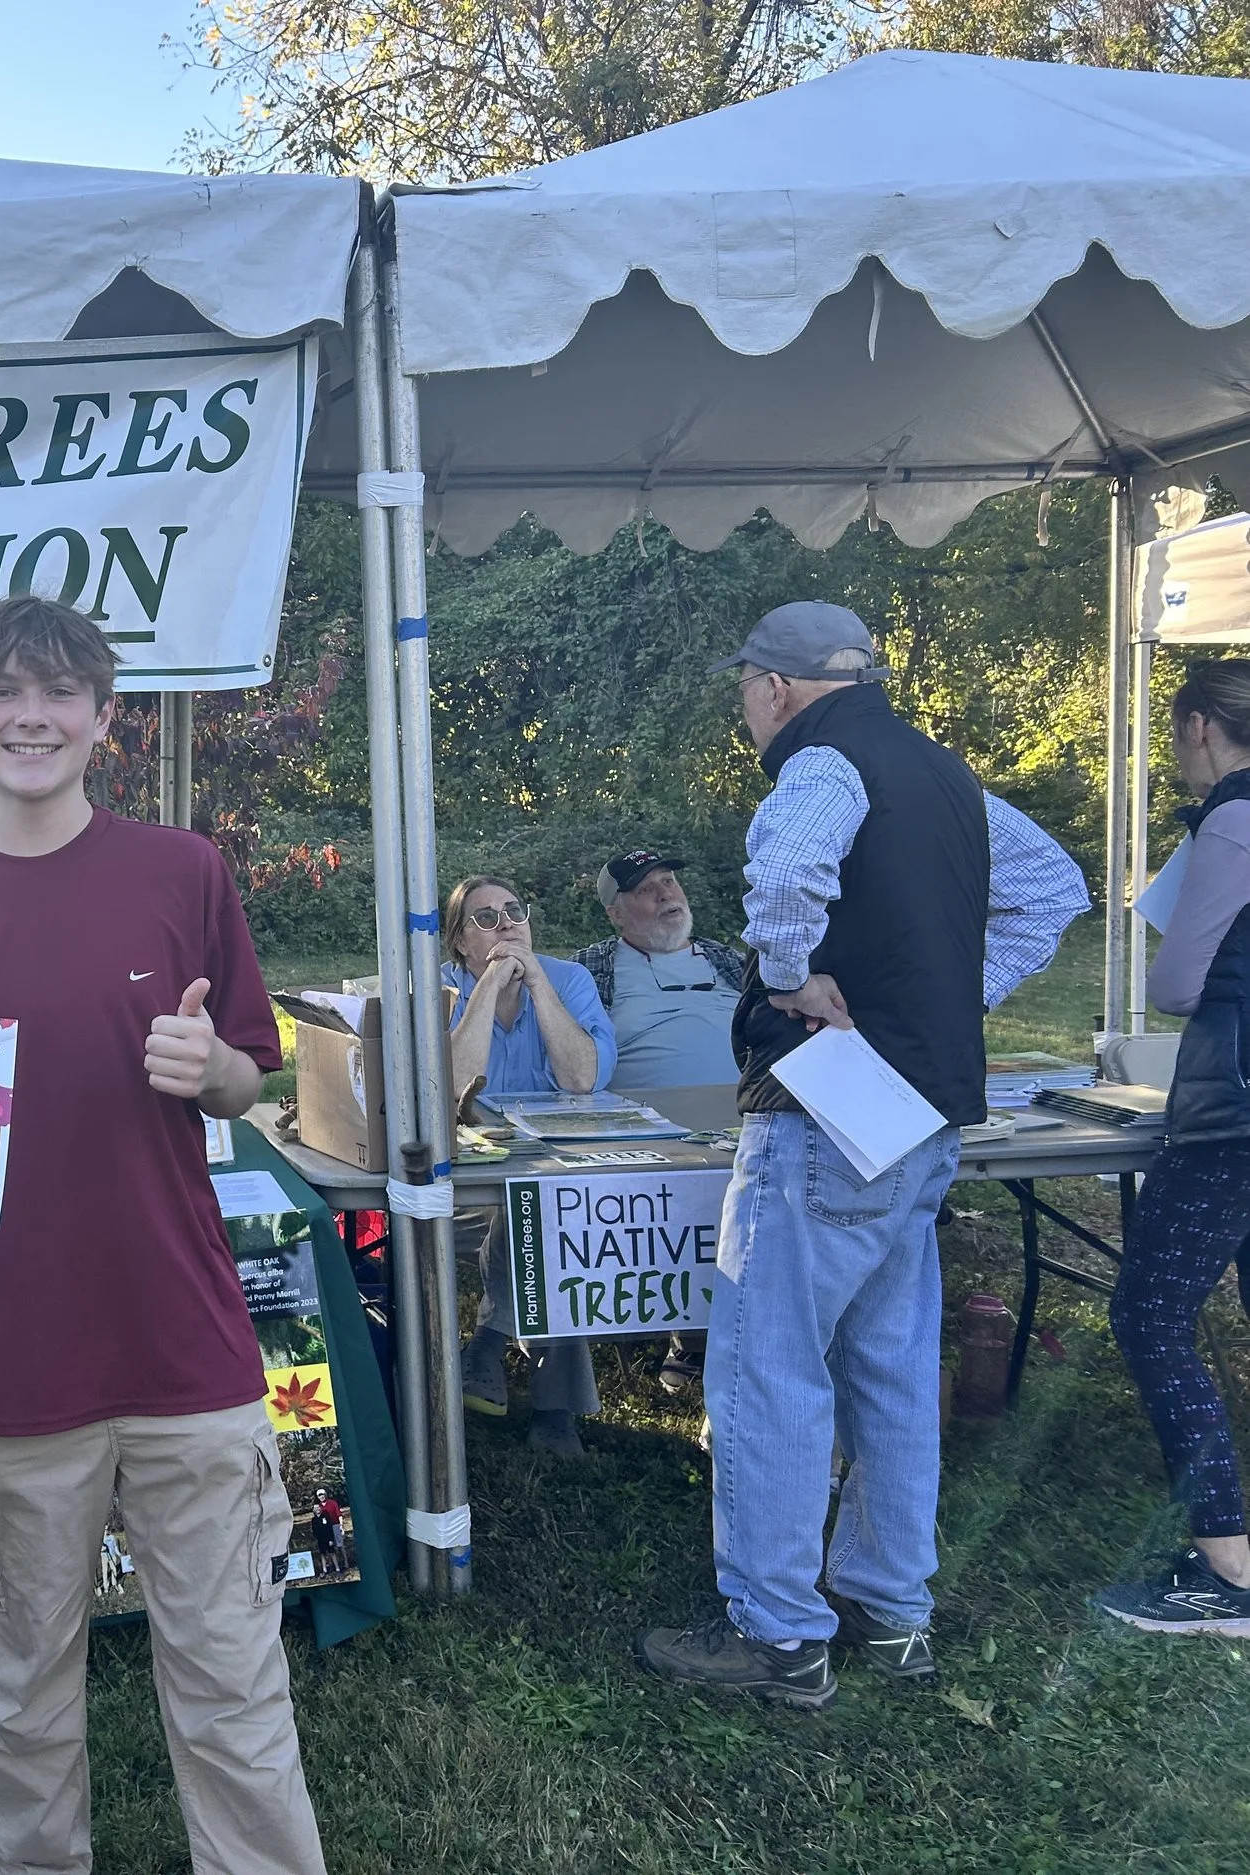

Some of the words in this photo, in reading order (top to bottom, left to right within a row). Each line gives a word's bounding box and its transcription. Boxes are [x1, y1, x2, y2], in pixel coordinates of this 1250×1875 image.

[555, 1183, 674, 1226] Plant
[558, 1224, 716, 1270] NATIVE
[237, 1259, 262, 1269] WHITE
[263, 1256, 280, 1266] OAK
[519, 1190, 539, 1326] PlantNovaTrees.org
[267, 1268, 284, 1277] alba
[251, 1282, 271, 1290] honor
[272, 1278, 281, 1287] of
[254, 1293, 275, 1301] Penny
[276, 1288, 300, 1298] Morrill
[558, 1269, 691, 1328] TREES!
[260, 1301, 299, 1311] Foundation
[300, 1297, 319, 1307] 2023
